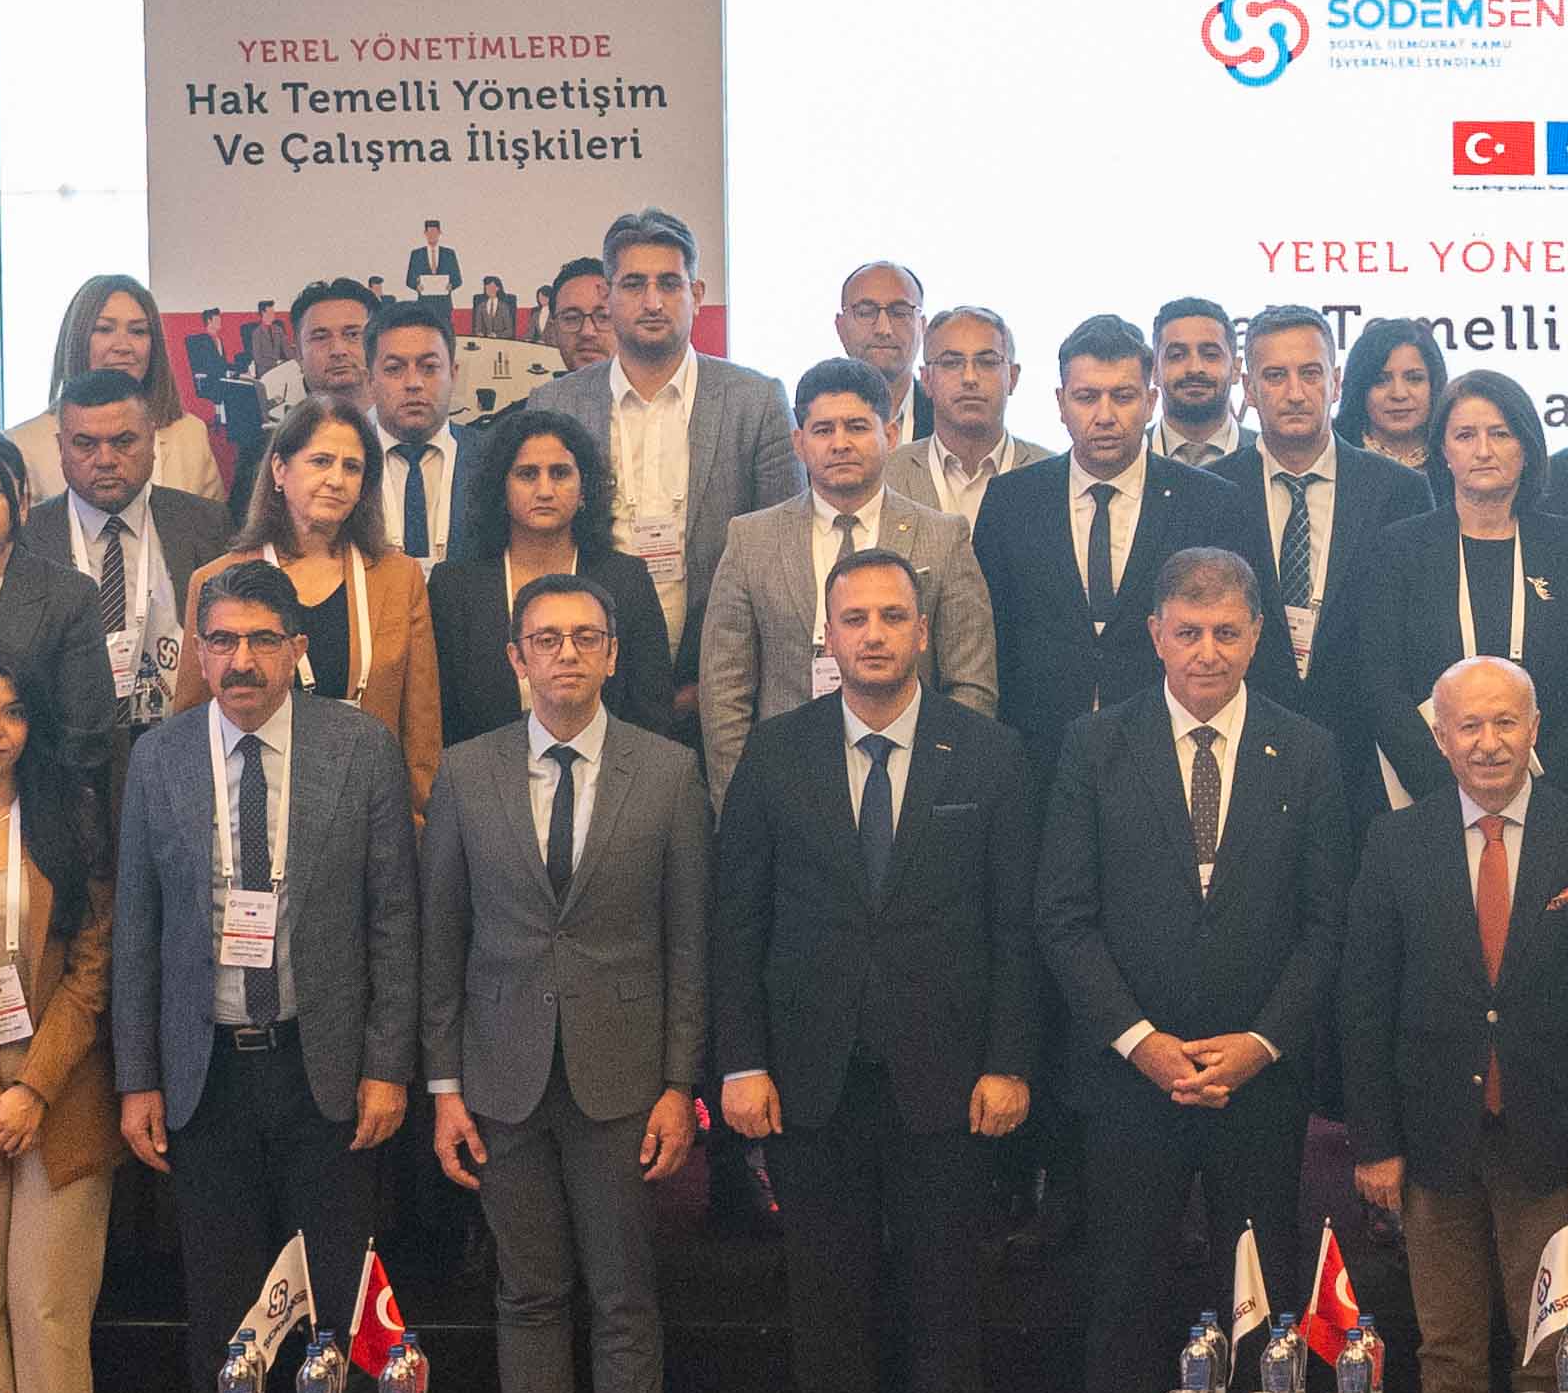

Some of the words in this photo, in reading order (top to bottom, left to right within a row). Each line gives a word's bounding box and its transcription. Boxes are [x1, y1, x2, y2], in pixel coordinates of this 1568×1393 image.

[238, 38, 340, 63] YEREL
[350, 31, 612, 63] YÖNETİMLERDE
[185, 82, 269, 116] Hak
[281, 80, 441, 114] Temelli
[452, 77, 668, 118] Yönetişim
[213, 133, 265, 166] Ve
[280, 132, 452, 173] Çalışma
[466, 122, 643, 170] İlişkileri
[1258, 240, 1409, 273] YEREL
[1323, 304, 1561, 351] Telli
